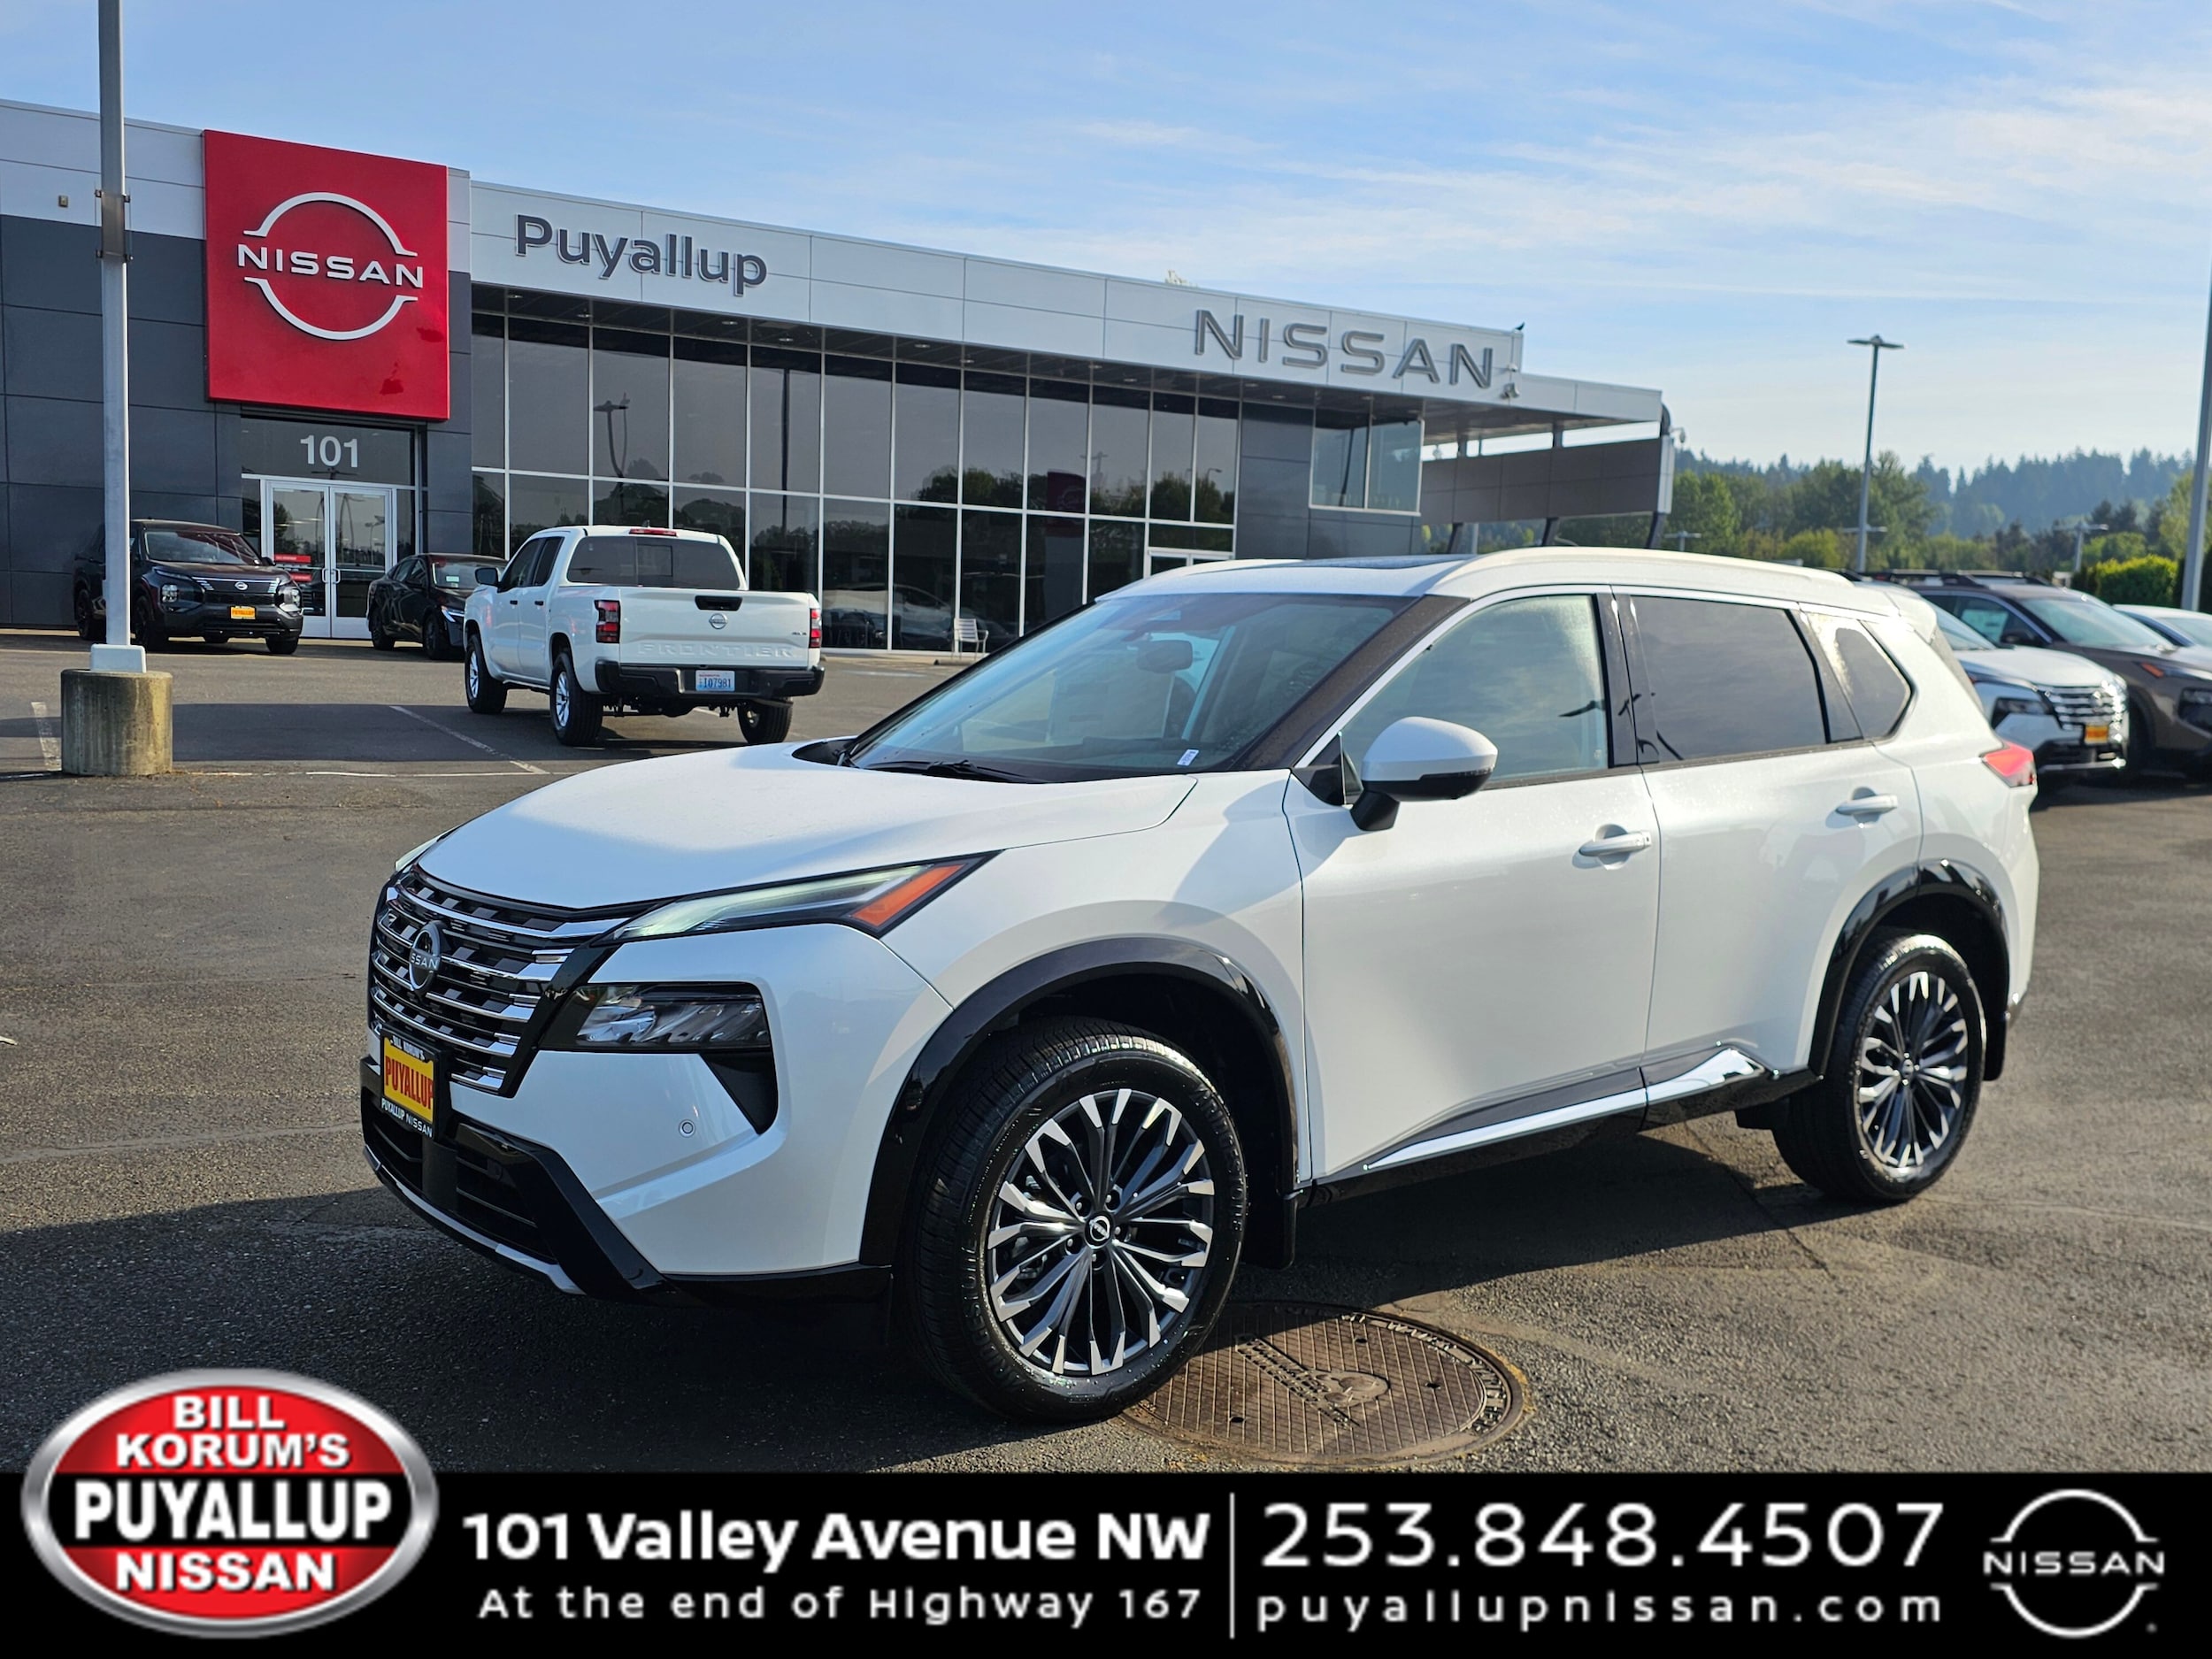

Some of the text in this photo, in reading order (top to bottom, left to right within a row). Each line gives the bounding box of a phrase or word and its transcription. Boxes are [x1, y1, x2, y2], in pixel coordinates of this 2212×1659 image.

[236, 242, 425, 289] NISSAN
[515, 213, 769, 297] Puyallup
[1194, 308, 1494, 389] NISSAN
[299, 434, 360, 469] 101
[637, 641, 794, 658] FRONTIER
[384, 1055, 434, 1110] PUYALLUP
[381, 1097, 433, 1138] PUYALLUP NISSAN
